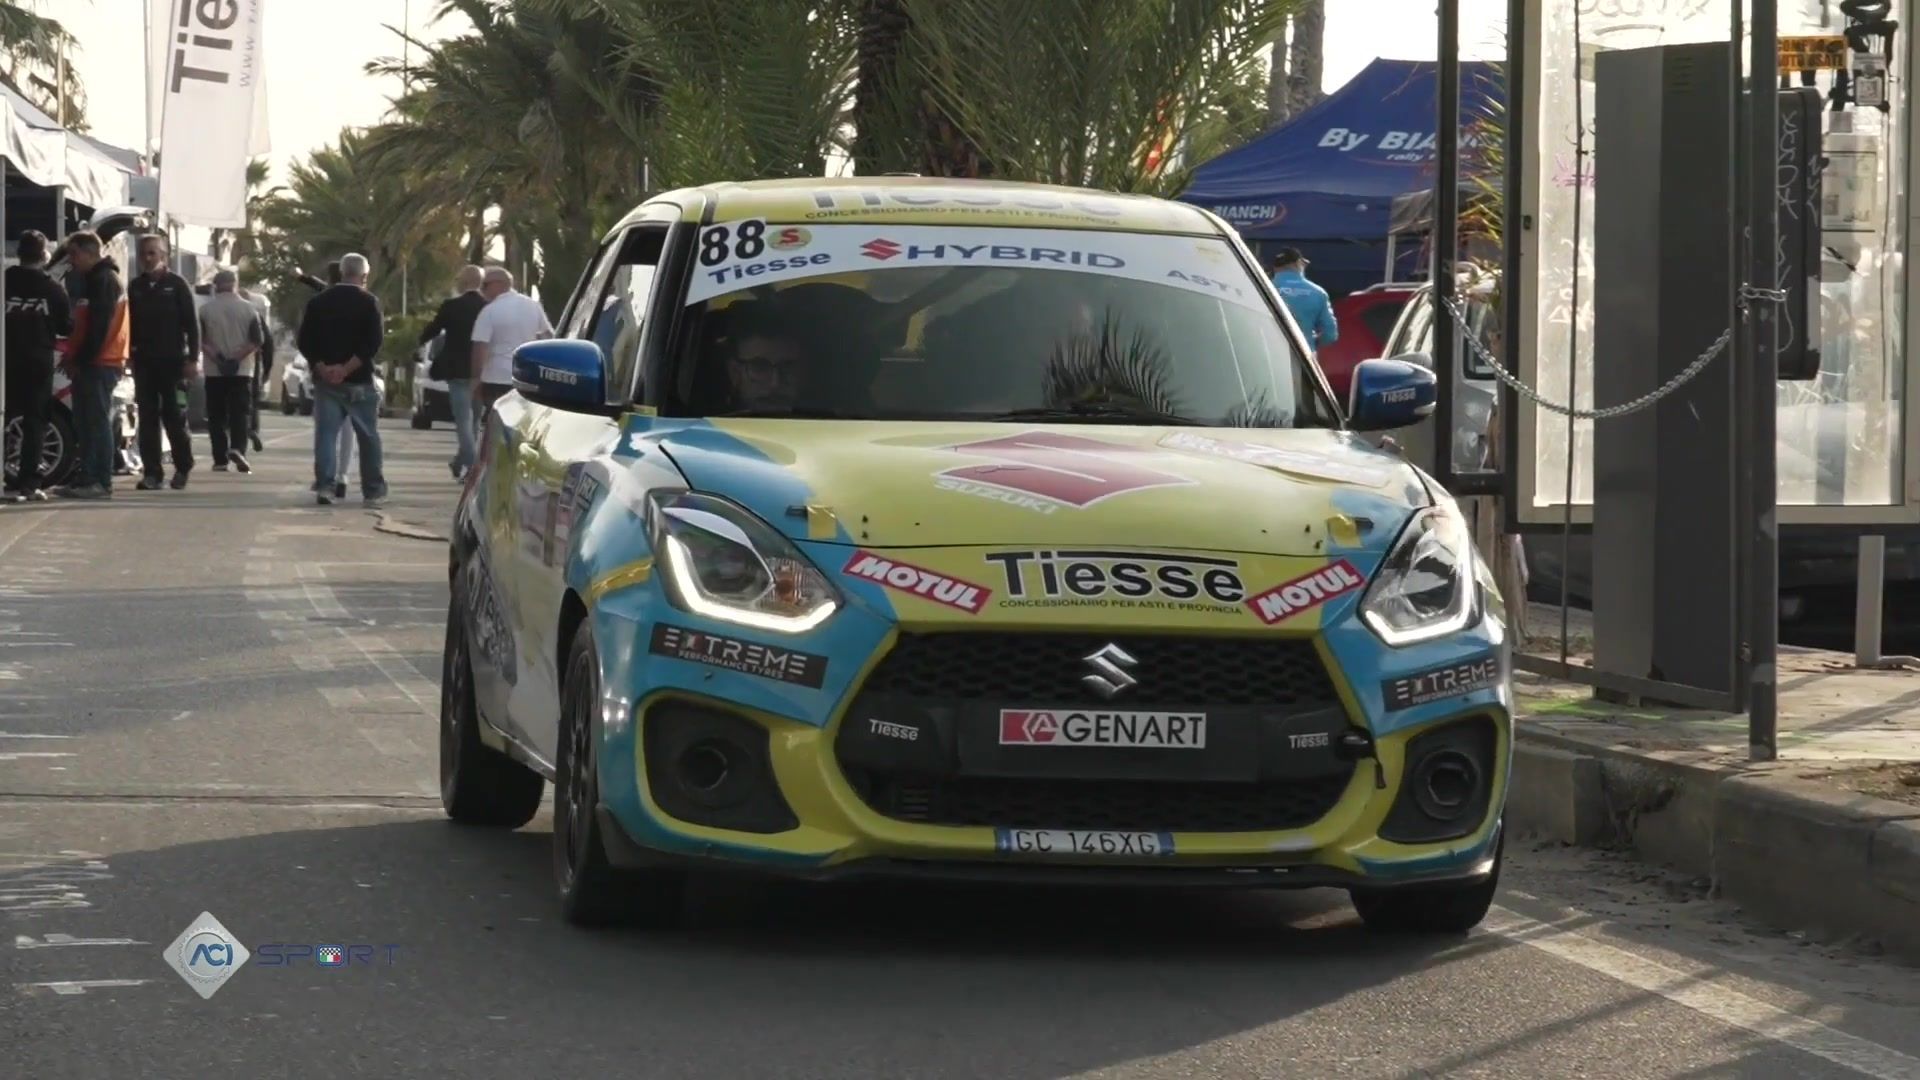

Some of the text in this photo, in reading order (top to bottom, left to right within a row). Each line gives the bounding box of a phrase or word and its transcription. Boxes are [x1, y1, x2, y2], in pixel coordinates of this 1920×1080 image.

[1318, 128, 1369, 150] By
[700, 219, 766, 267] 88
[907, 244, 1126, 269] HYBRID
[708, 252, 831, 285] Tiesse
[850, 556, 981, 609] MOTUL
[985, 550, 1244, 602] Tiesse
[1256, 565, 1360, 620] MOTUL
[999, 600, 1108, 608] CONCESSIONARIO
[1111, 600, 1136, 608] PER
[1139, 600, 1165, 609] ASTI
[1178, 603, 1242, 615] PROVINCIA
[678, 650, 748, 672] PERFORMANCE
[869, 718, 919, 741] Tiesse
[1062, 713, 1203, 745] GENART
[1016, 831, 1155, 855] GC 146XG
